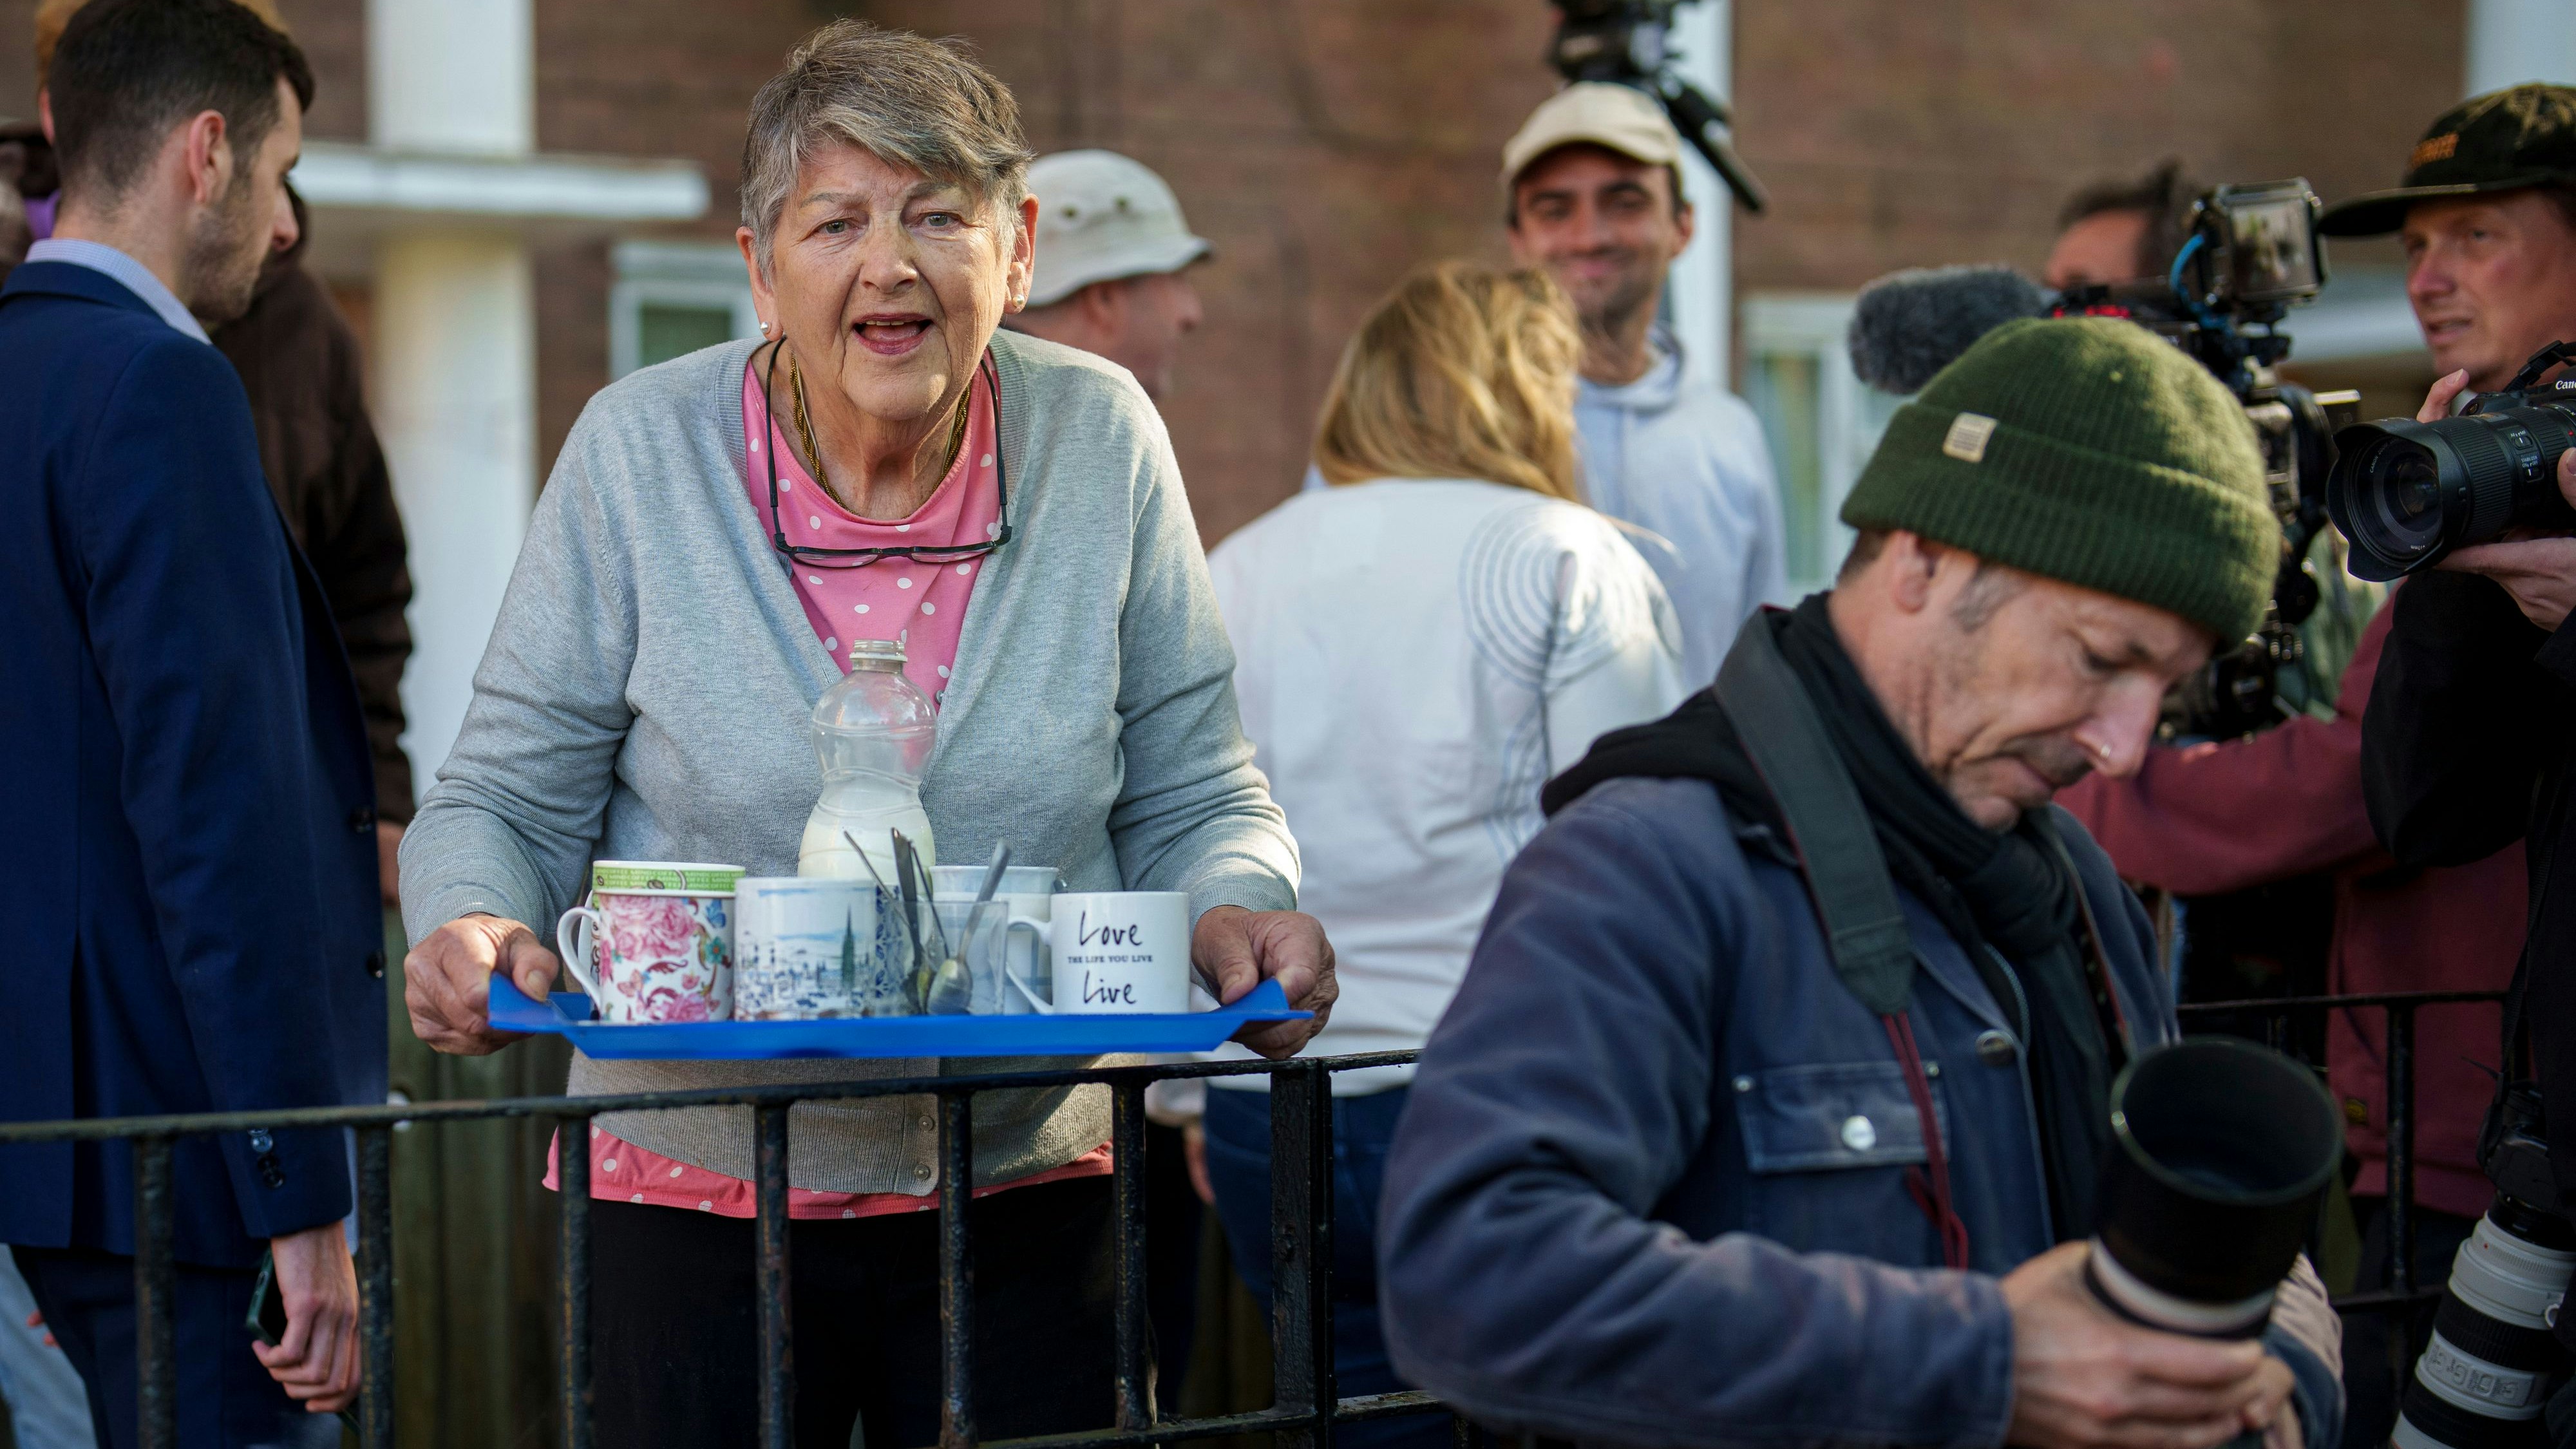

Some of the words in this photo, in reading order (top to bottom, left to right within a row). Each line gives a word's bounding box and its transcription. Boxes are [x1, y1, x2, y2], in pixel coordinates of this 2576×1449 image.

[2555, 380, 2576, 390] Can
[1079, 911, 1142, 945] Love
[1083, 970, 1137, 1004] Live
